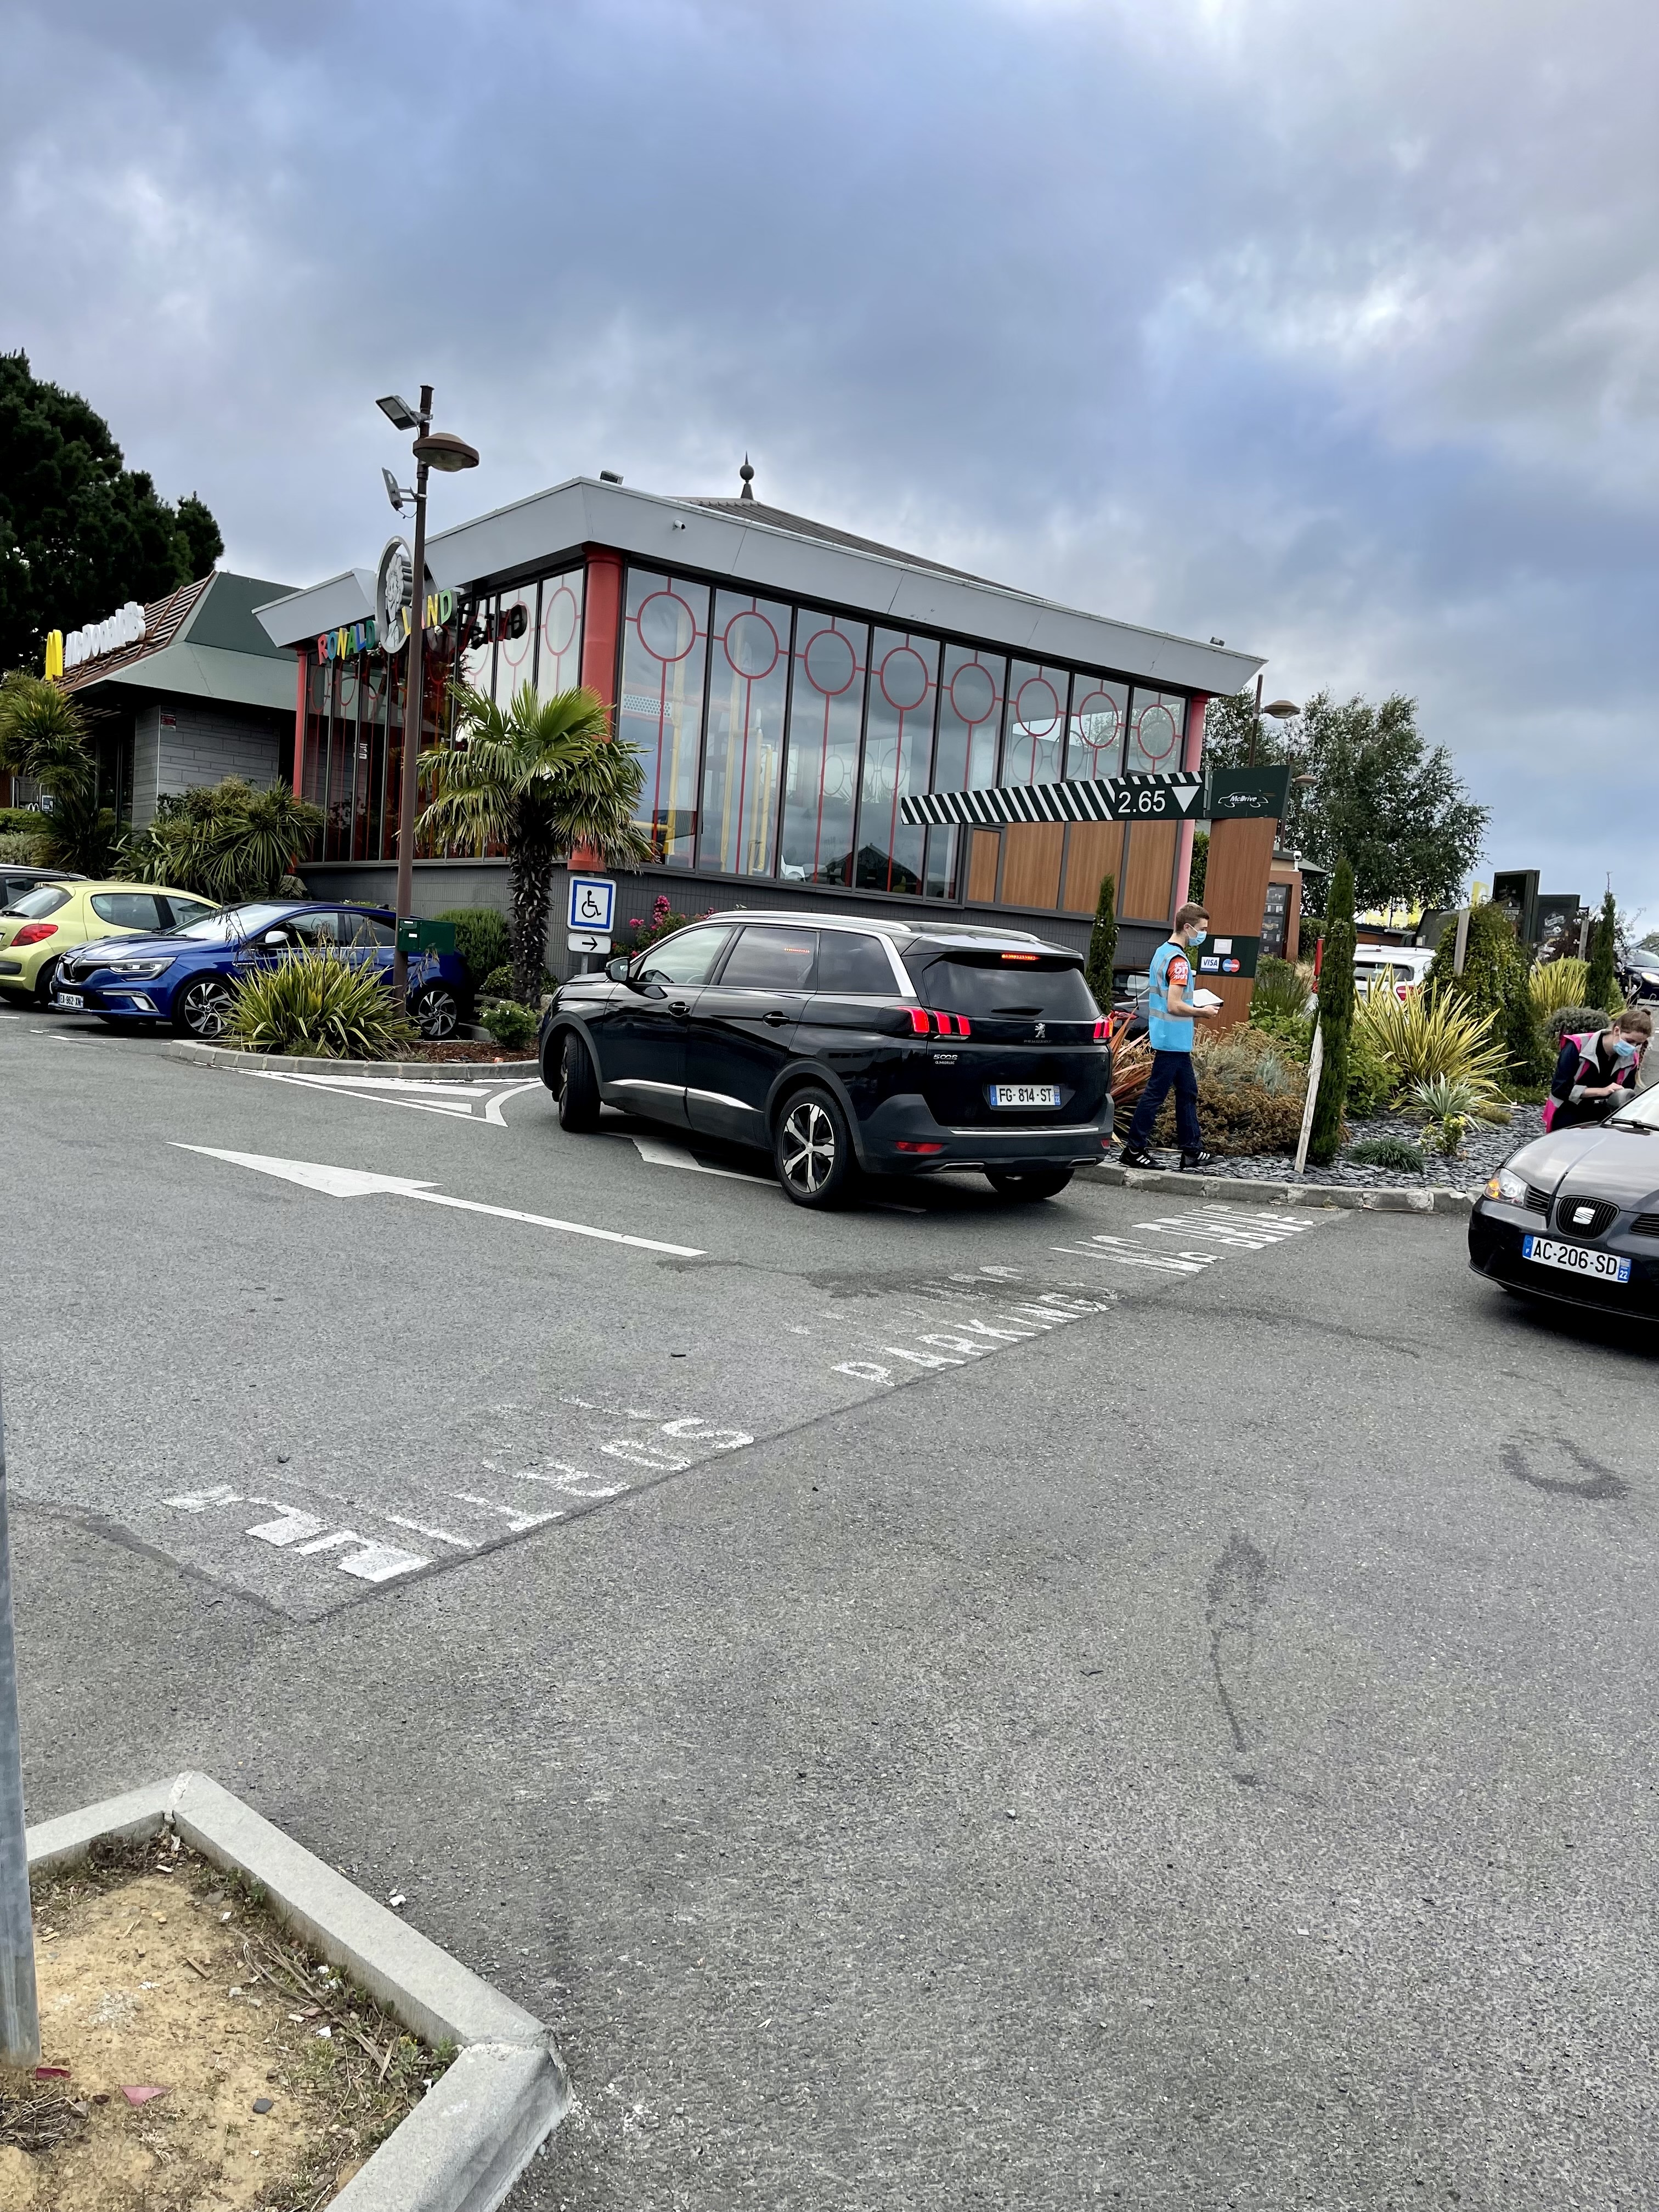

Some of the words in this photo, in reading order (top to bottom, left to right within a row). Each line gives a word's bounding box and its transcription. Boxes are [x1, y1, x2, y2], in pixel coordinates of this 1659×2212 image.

[318, 620, 379, 665] RONALD
[402, 589, 456, 636] LND
[1118, 790, 1166, 814] 2.65
[999, 1088, 1052, 1102] FG-814-ST
[1131, 1204, 1315, 1250] DRIVE
[1533, 1240, 1618, 1275] AC-206-SD
[1619, 1270, 1628, 1279] 22
